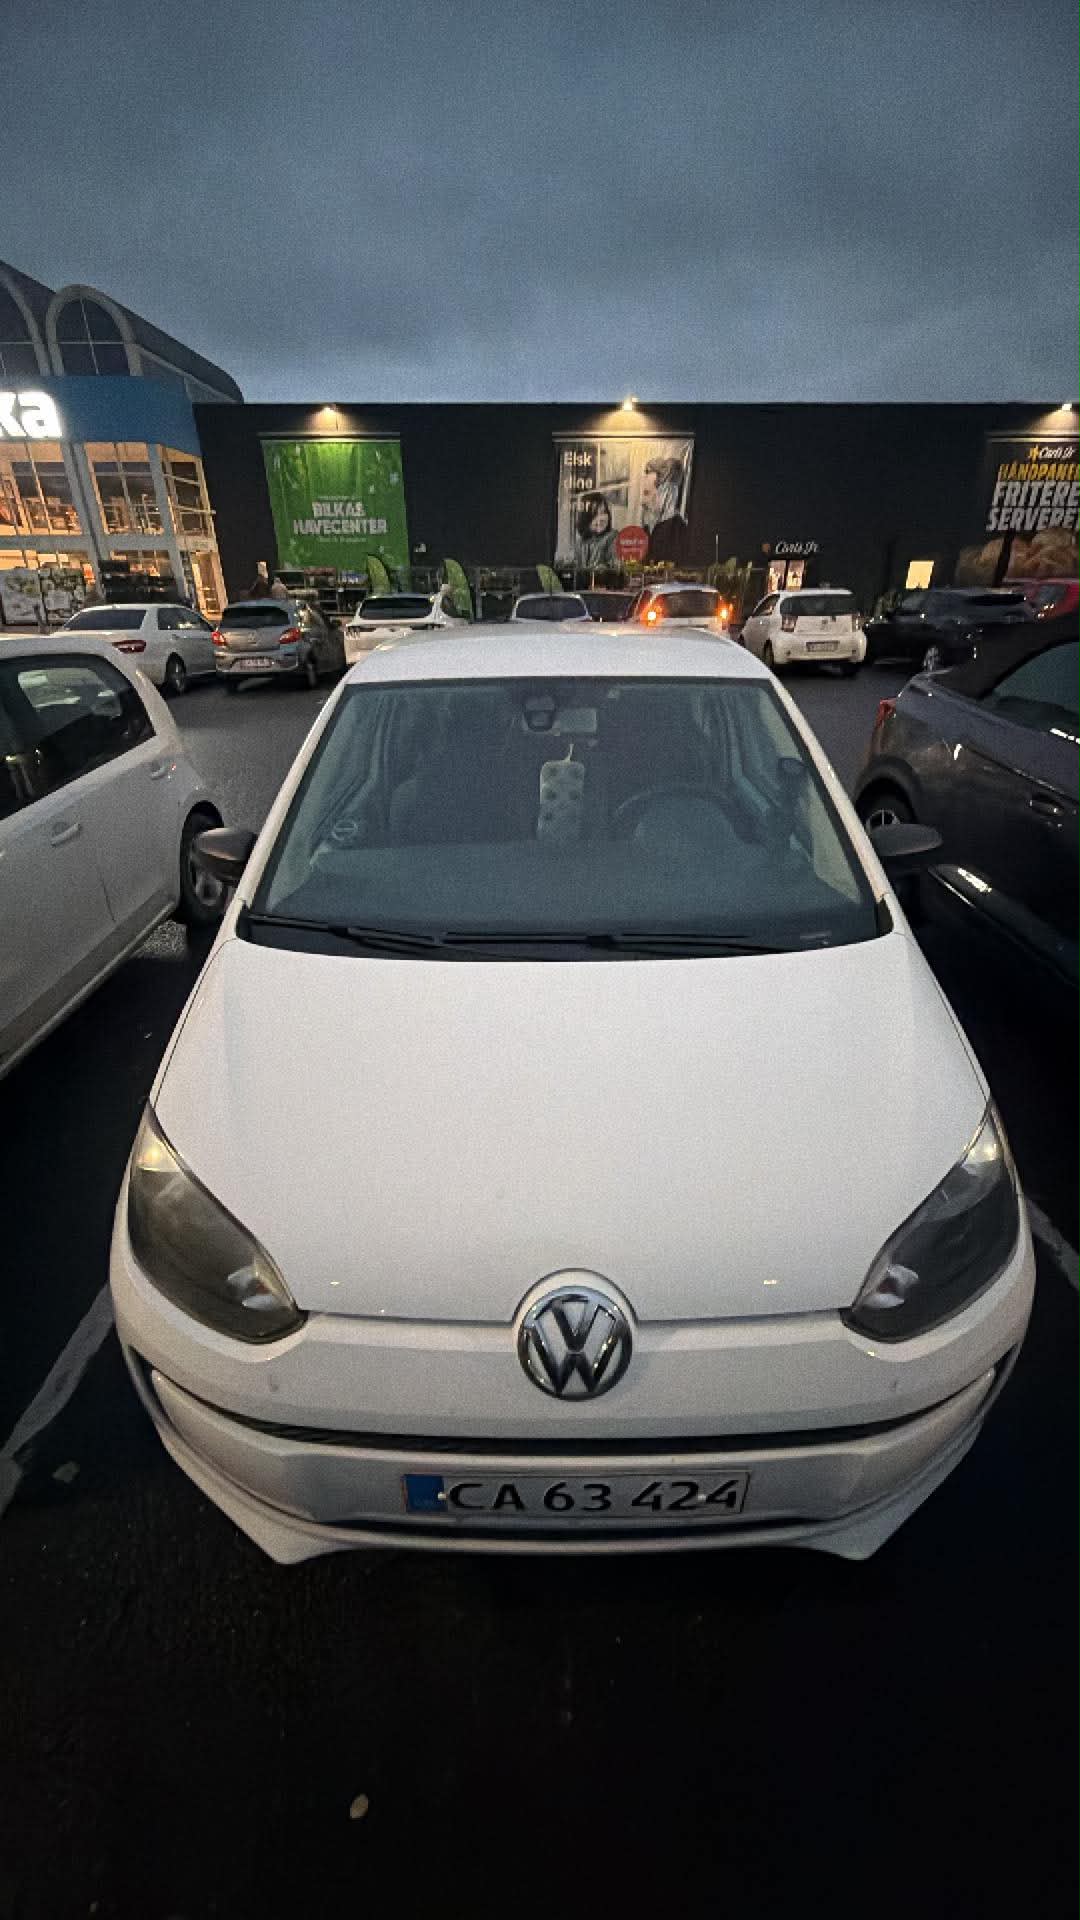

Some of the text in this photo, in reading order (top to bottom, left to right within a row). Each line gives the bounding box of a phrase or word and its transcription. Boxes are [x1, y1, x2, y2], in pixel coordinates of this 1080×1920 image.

[564, 451, 592, 466] Elsk
[293, 519, 387, 535] HAVECENTER
[986, 507, 1080, 531] SERVERE
[448, 1479, 739, 1513] CA 63 424
